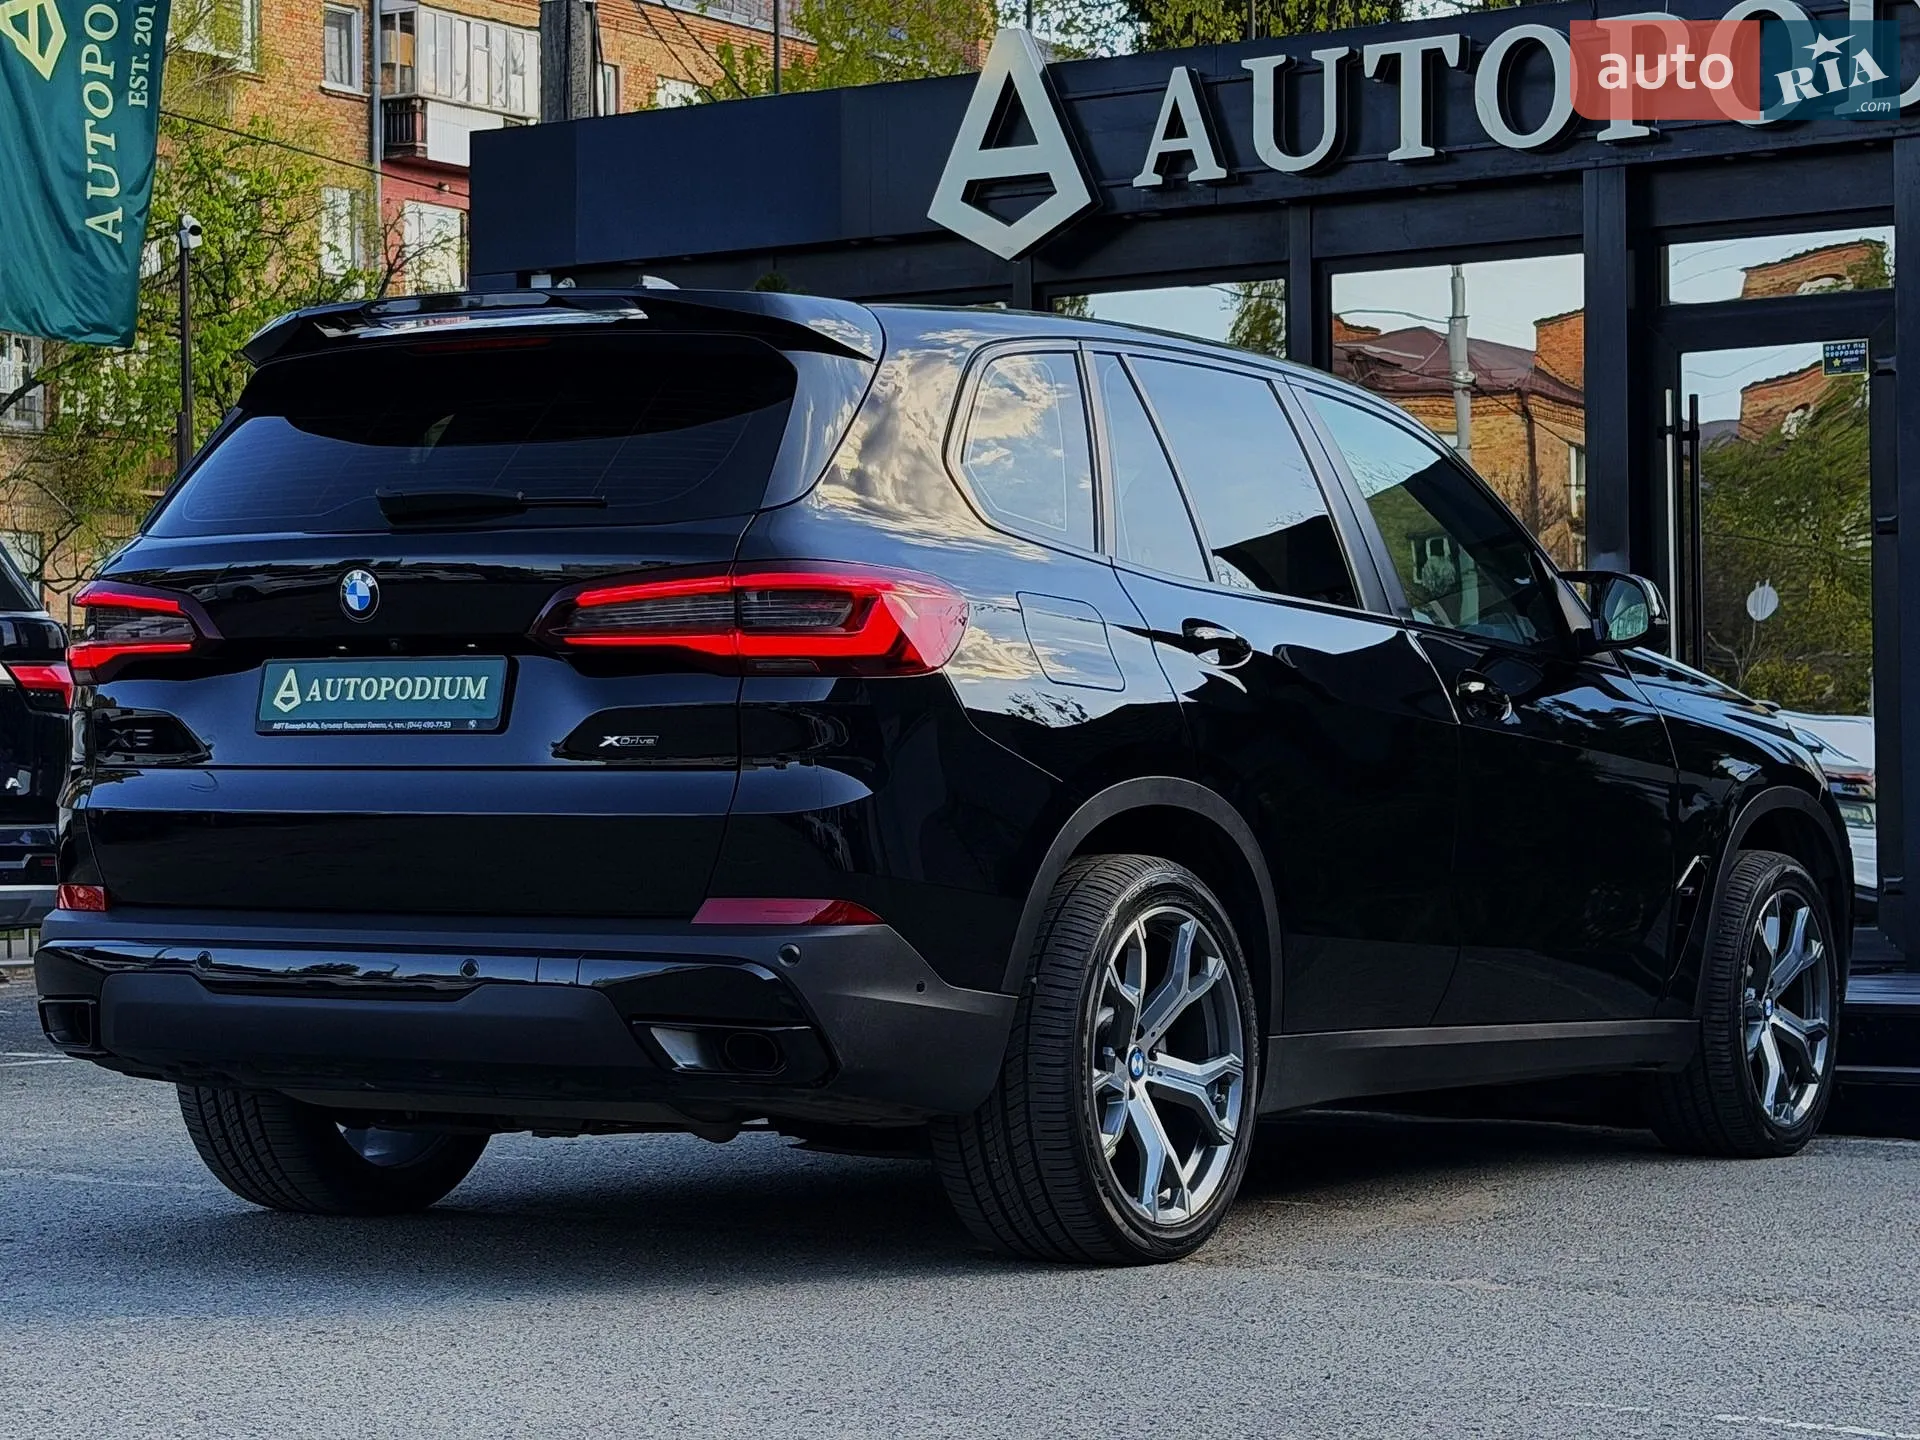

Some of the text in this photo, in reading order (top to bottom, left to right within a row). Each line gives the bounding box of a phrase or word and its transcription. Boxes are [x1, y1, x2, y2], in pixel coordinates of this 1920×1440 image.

[128, 0, 156, 109] EST. 201
[81, 0, 123, 244] AUTOPO
[305, 676, 489, 702] AUTOPODIUM
